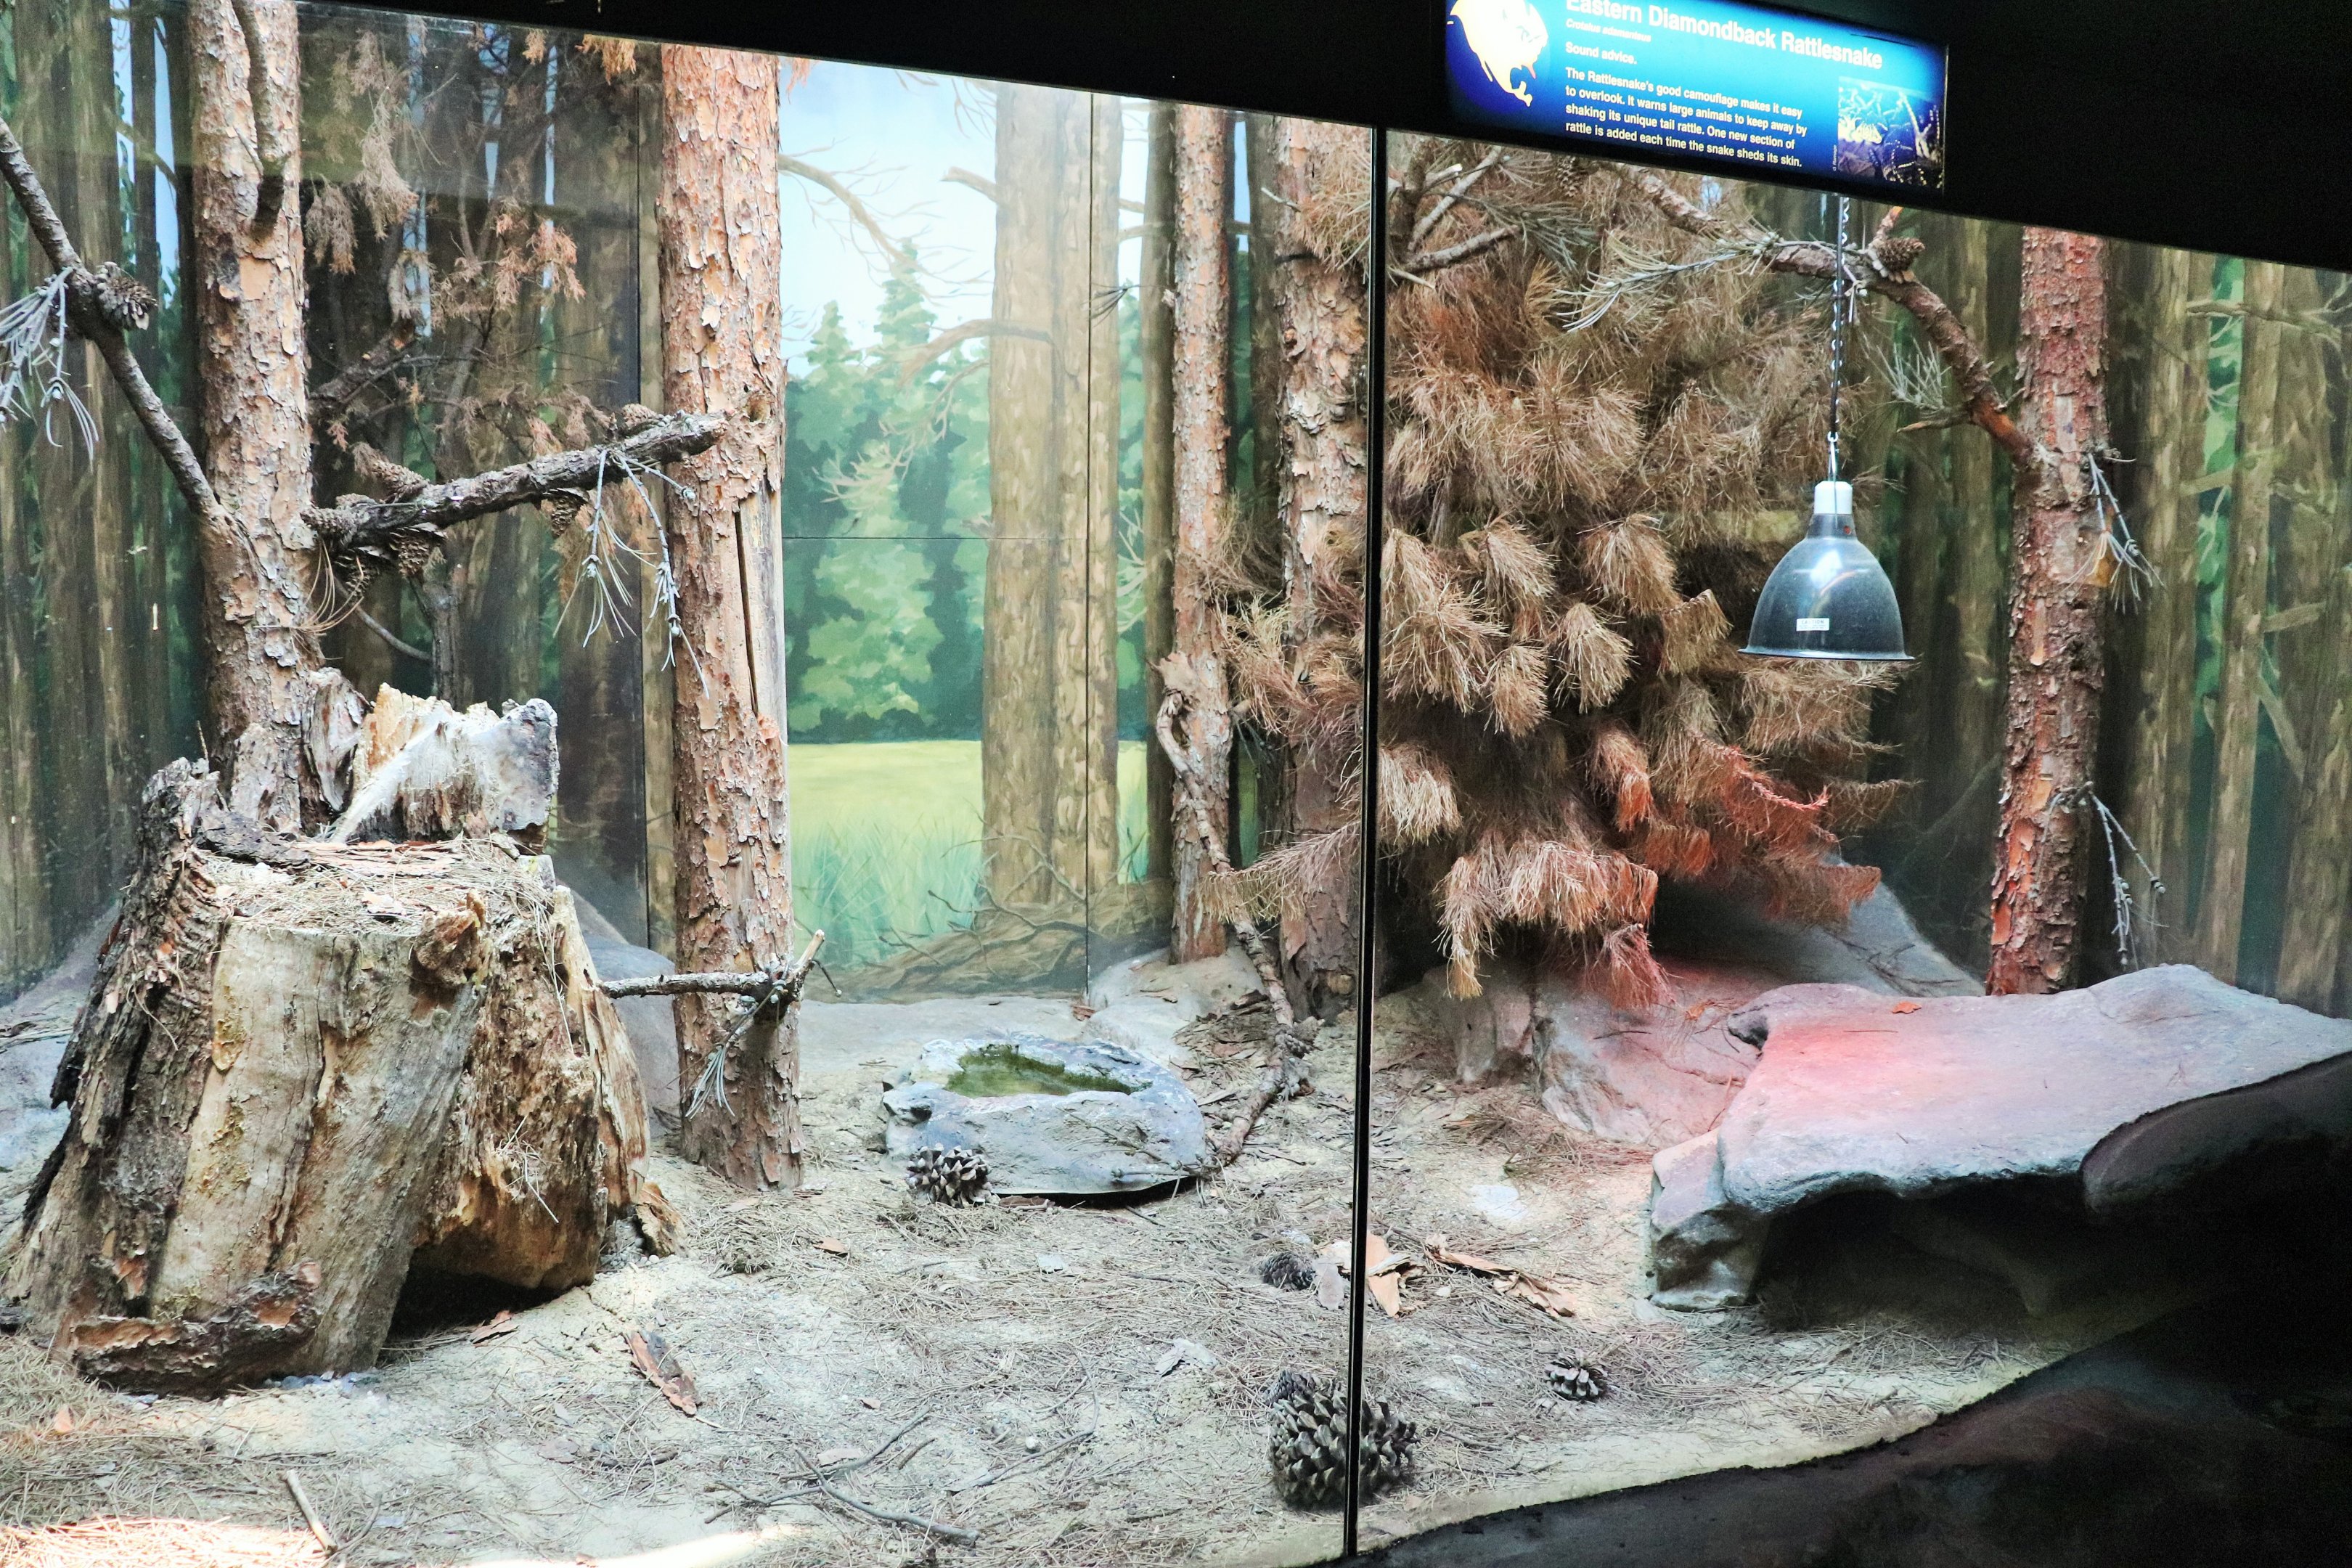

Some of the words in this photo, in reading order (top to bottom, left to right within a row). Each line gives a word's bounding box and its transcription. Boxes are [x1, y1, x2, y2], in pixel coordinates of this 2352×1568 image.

[1565, 41, 1599, 58] Sound
[1601, 49, 1637, 64] advice.
[1649, 4, 1776, 49] Diamondback
[1781, 31, 1882, 69] Rattlesnake
[1565, 67, 1585, 81] The
[1657, 85, 1681, 97] good
[1684, 89, 1739, 108] camouflage
[1741, 99, 1771, 113] makes
[1773, 102, 1779, 113] it
[1781, 106, 1802, 120] easy
[1565, 85, 1576, 97] to
[1579, 89, 1625, 105] overlook.
[1628, 95, 1635, 106] It
[1637, 98, 1667, 112] warns
[1670, 102, 1694, 118] large
[1696, 108, 1732, 123] animals
[1734, 113, 1744, 124] to
[1747, 115, 1769, 130] keep
[1771, 121, 1794, 135] away
[1796, 123, 1807, 137] by
[1566, 103, 1606, 122] shaking
[1609, 109, 1621, 122] its
[1624, 114, 1657, 128] unique
[1660, 118, 1675, 130] tail
[1678, 122, 1704, 135] rattle.
[1707, 126, 1726, 139] One
[1728, 131, 1748, 142] new
[1749, 135, 1783, 148] section
[1785, 139, 1795, 150] of
[1566, 122, 1592, 134] rattle
[1595, 125, 1604, 136] is
[1606, 128, 1637, 142] added
[1640, 134, 1663, 145] each
[1665, 136, 1686, 149] time
[1689, 140, 1704, 152] the
[1707, 144, 1734, 157] snake
[1737, 148, 1765, 161] sheds
[1767, 152, 1779, 163] its
[1781, 155, 1802, 167] skin.
